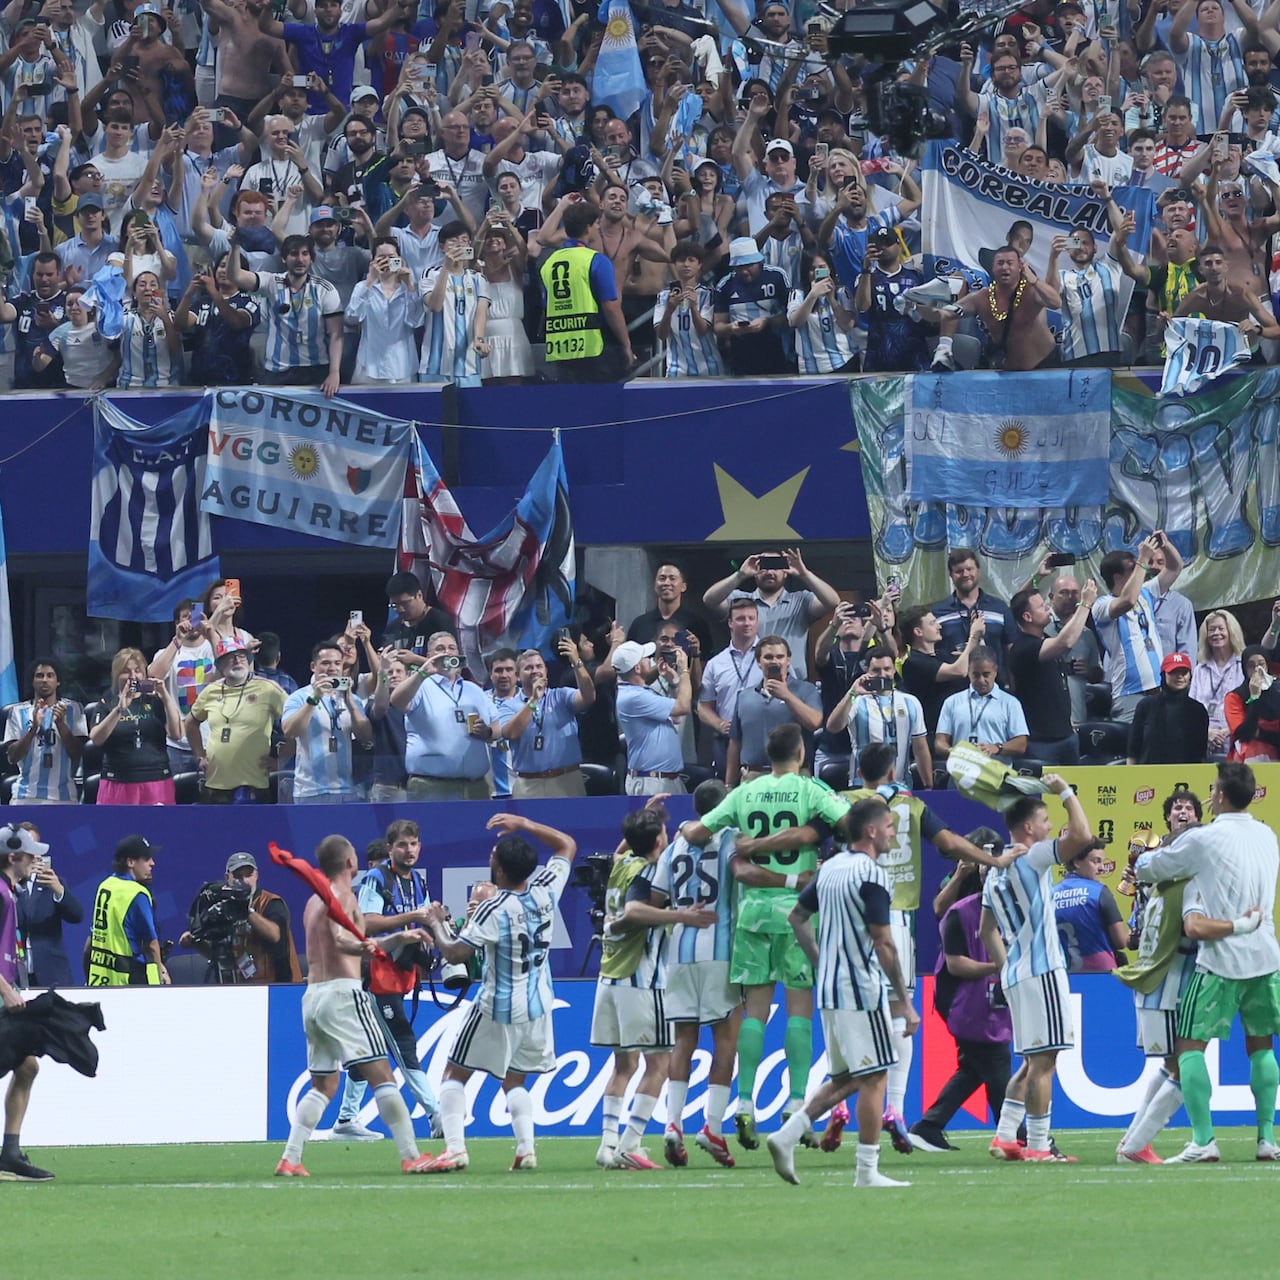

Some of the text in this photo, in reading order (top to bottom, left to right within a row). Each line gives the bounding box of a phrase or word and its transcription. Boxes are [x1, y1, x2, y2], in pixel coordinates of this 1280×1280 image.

[760, 282, 776, 297] 10
[1079, 282, 1093, 300] 10
[876, 294, 888, 312] 9
[18, 316, 32, 334] 10
[196, 309, 208, 327] 10
[546, 315, 589, 332] ECURITY
[678, 313, 692, 332] 10
[214, 390, 396, 448] CORONEL
[209, 431, 282, 467] VGG
[200, 479, 388, 540] AGUIRRE
[1097, 785, 1117, 794] FAN
[1133, 821, 1153, 830] FAN
[747, 810, 800, 866] 23
[673, 849, 721, 908] 25
[1053, 887, 1090, 900] DIGITAL
[1054, 896, 1088, 910] KETING
[518, 919, 553, 975] 15
